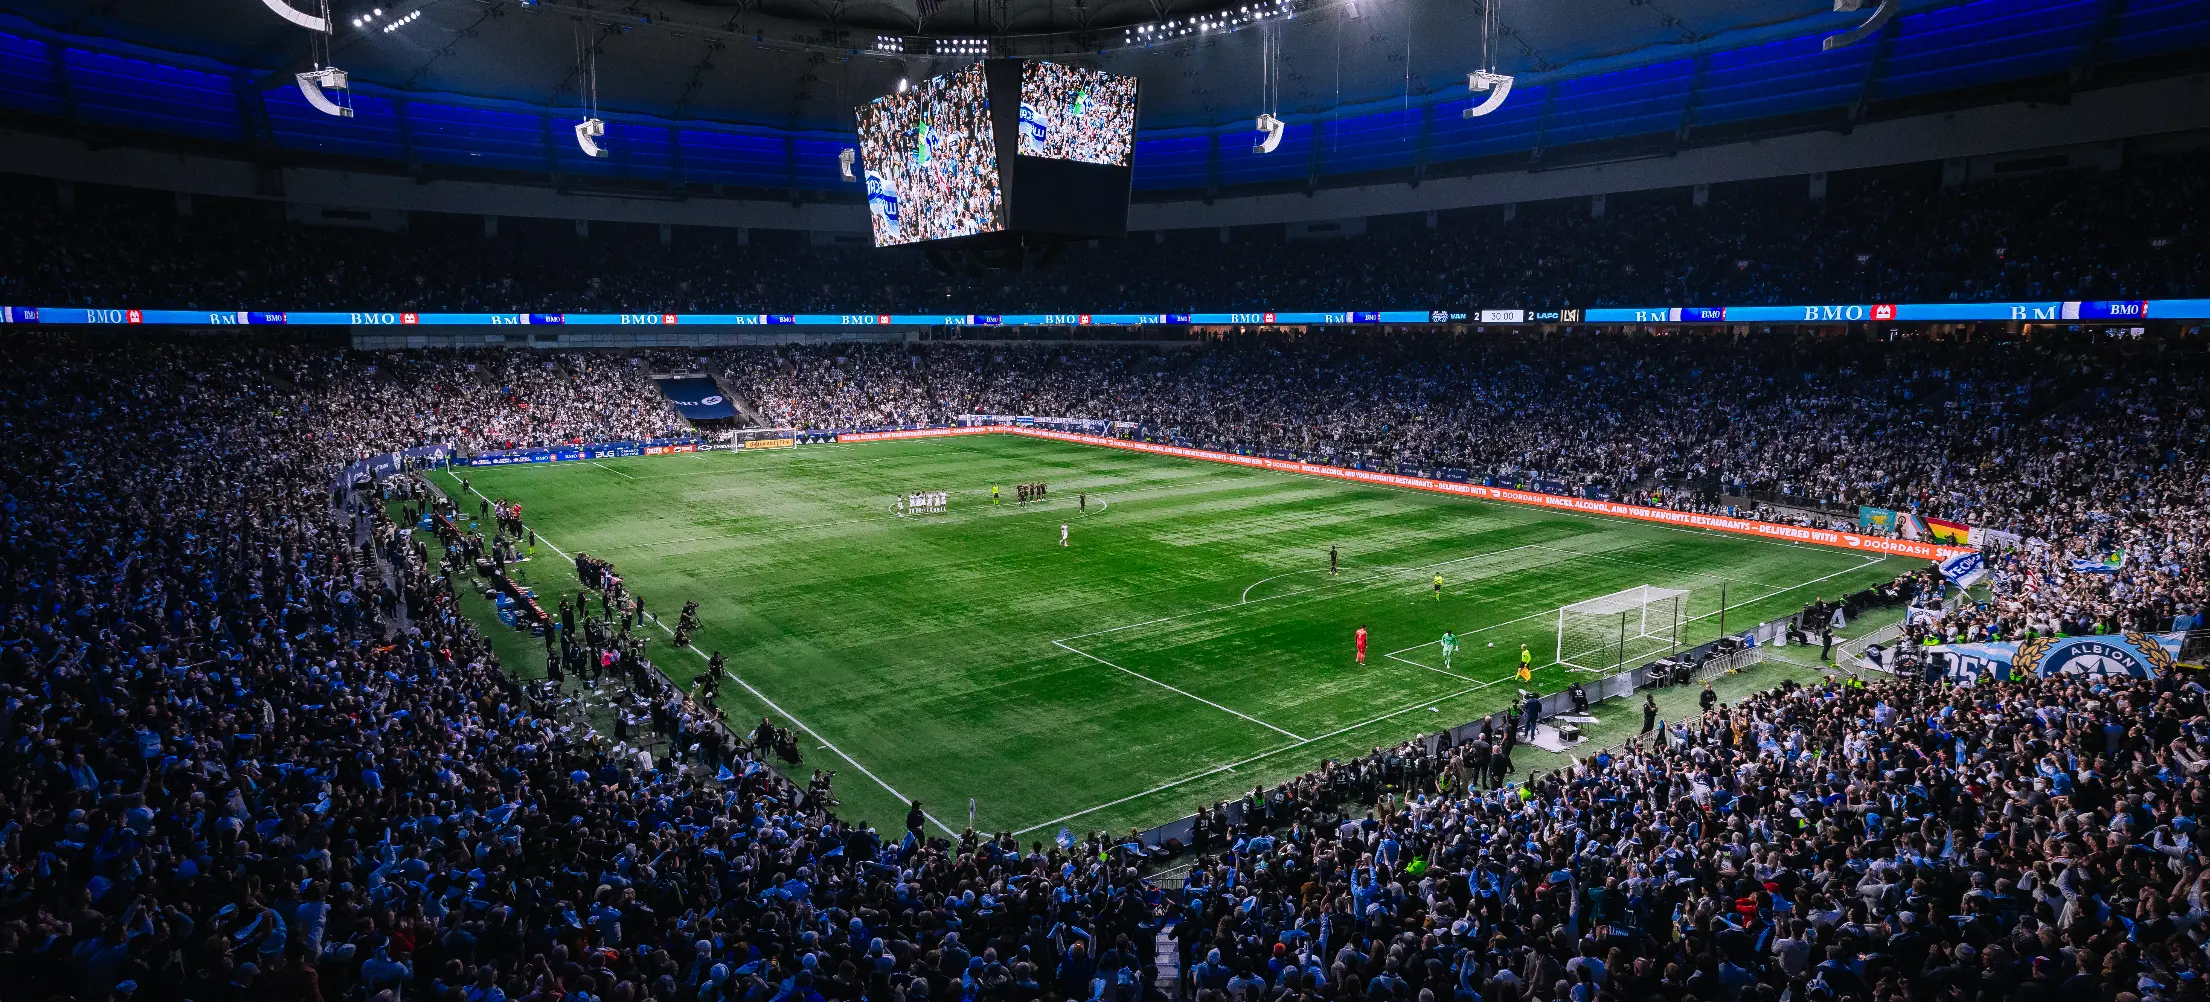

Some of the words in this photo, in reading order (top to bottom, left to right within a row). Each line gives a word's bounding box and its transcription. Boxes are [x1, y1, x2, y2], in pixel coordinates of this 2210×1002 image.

[1701, 310, 1720, 319] BMO
[1805, 305, 1863, 321] BMO
[2110, 304, 2139, 315] BMO
[87, 309, 122, 324] BMO
[265, 314, 283, 322] BMO
[351, 313, 394, 325] BMO
[620, 314, 658, 325] BMO
[841, 315, 874, 325] BMO
[1045, 314, 1076, 324] BMO
[1230, 313, 1260, 324] BMO
[1474, 312, 1480, 321] 2
[1528, 311, 1534, 321] 2
[1536, 312, 1559, 320] LAFC
[595, 450, 615, 459] BLG
[1502, 491, 1542, 503] DOORDASH
[1545, 497, 1574, 508] SNACKS,
[1575, 500, 1610, 513] ALCOHOL,
[1611, 505, 1628, 515] AND
[1629, 507, 1650, 518] YOUR
[1651, 510, 1689, 522] FAVORITE
[1690, 515, 1750, 531] RESTAURANTS
[1759, 524, 1810, 540] DELIVERED
[1811, 529, 1838, 543] WITH
[1863, 539, 1930, 555] DOORDASH
[2071, 644, 2136, 668] ALBION
